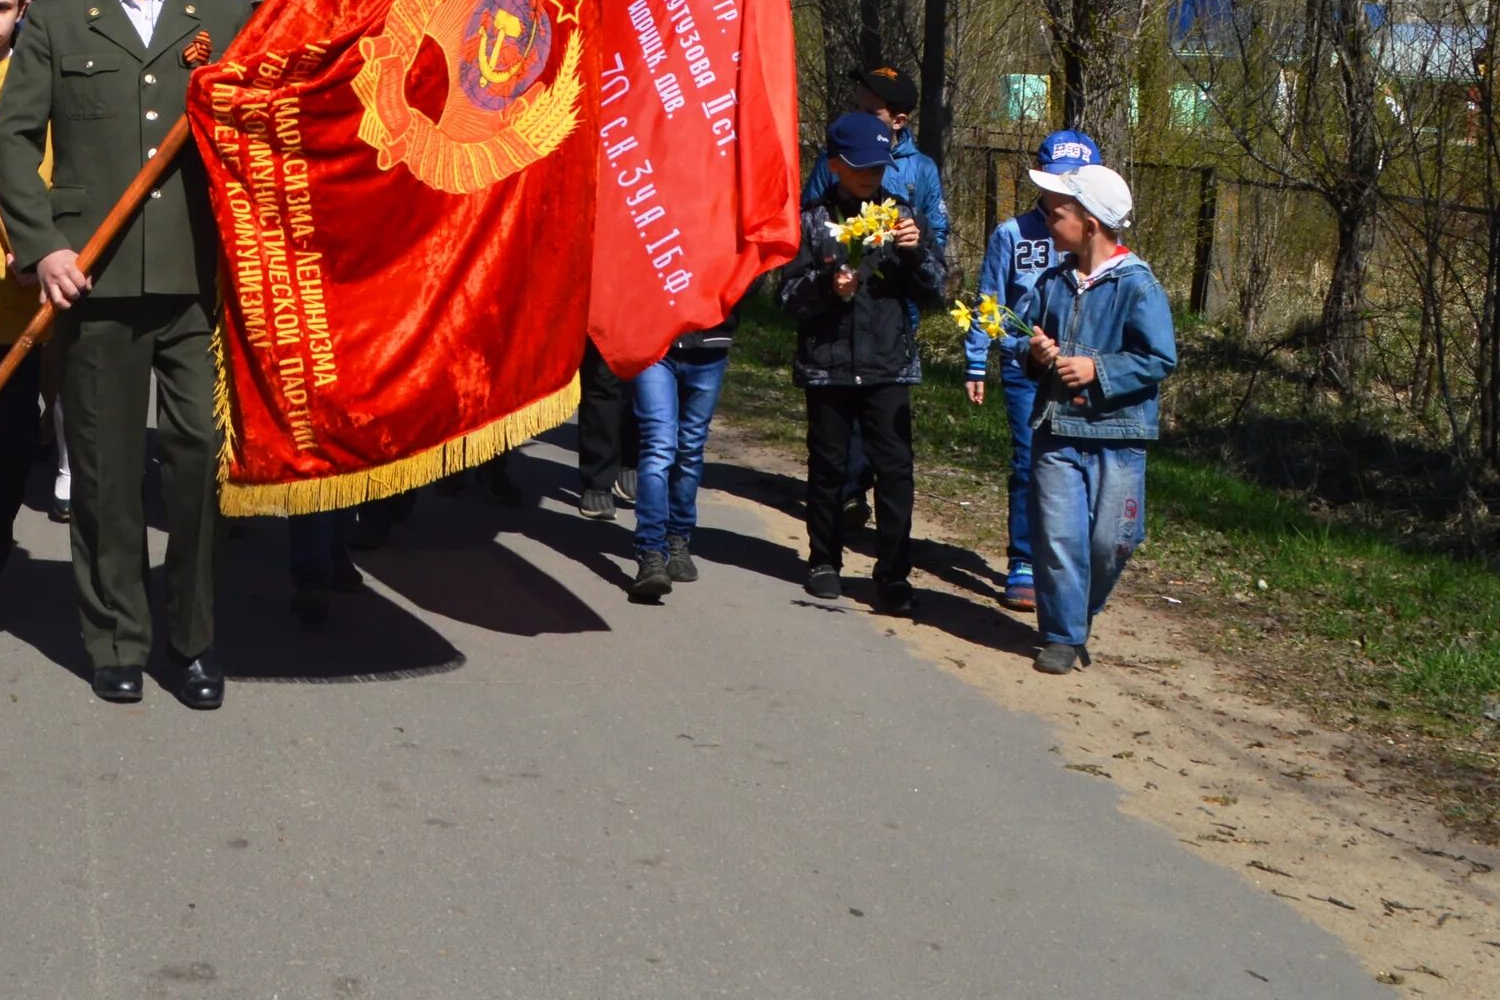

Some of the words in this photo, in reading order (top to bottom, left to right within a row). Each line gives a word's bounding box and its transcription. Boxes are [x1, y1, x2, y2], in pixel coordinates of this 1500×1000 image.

[221, 61, 247, 80] К
[225, 182, 272, 347] КОММУНИЗМА!
[1015, 239, 1049, 270] 23
